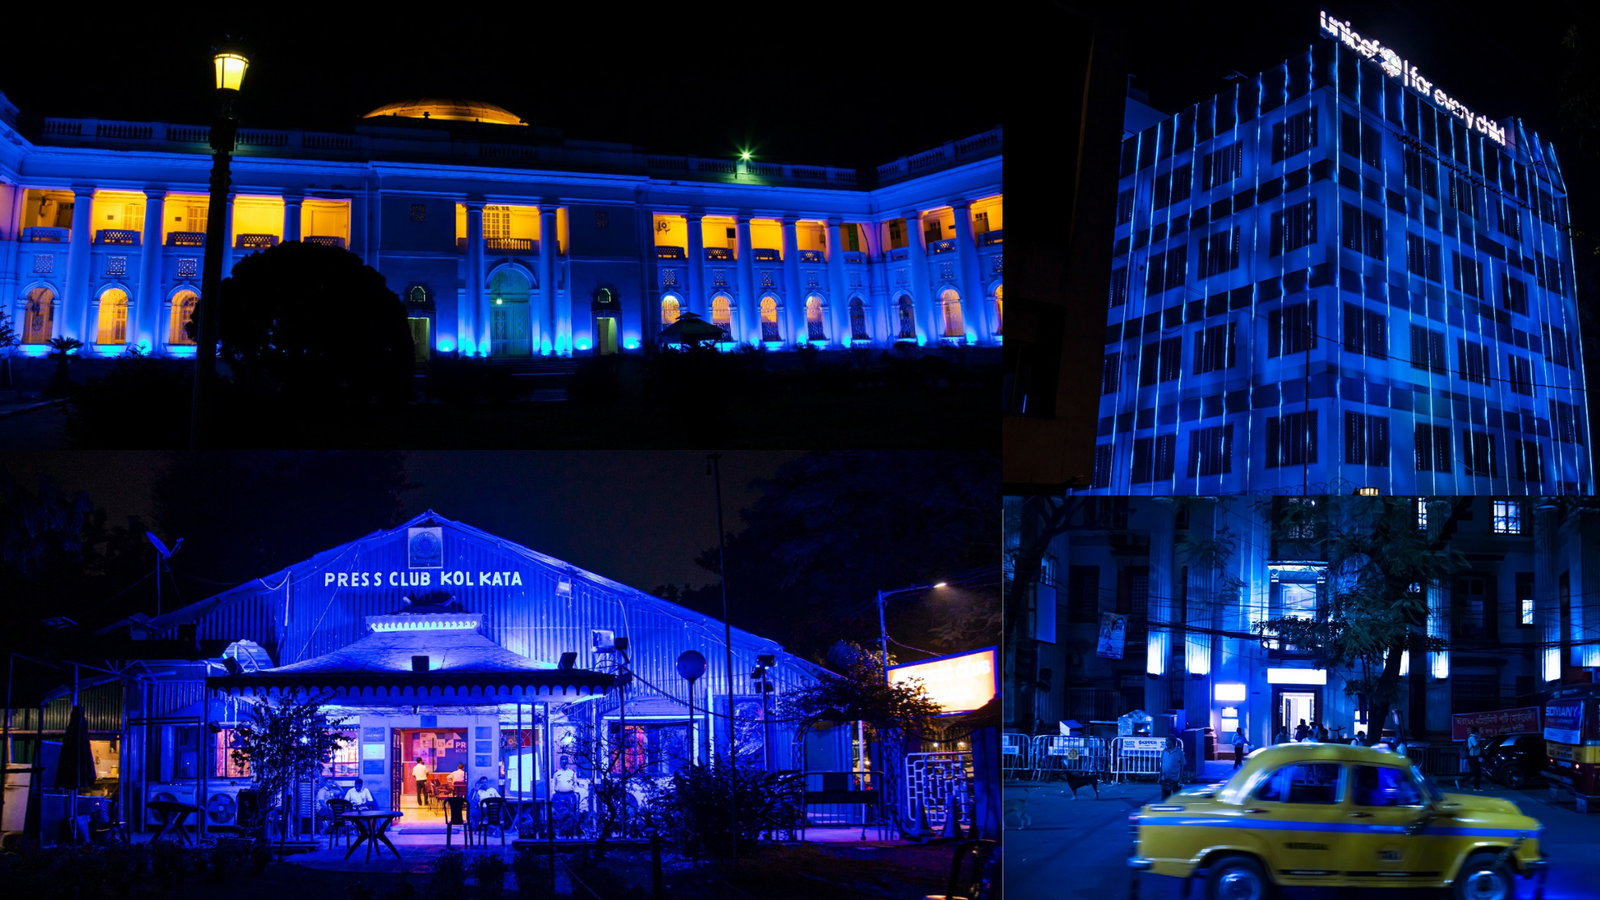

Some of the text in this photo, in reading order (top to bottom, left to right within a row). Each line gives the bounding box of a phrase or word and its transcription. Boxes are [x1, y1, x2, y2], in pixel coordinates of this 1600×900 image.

[1320, 10, 1506, 146] unicef for every child
[324, 571, 382, 587] PRESS
[389, 571, 431, 587] CLUB
[1545, 706, 1579, 718] SOMANY
